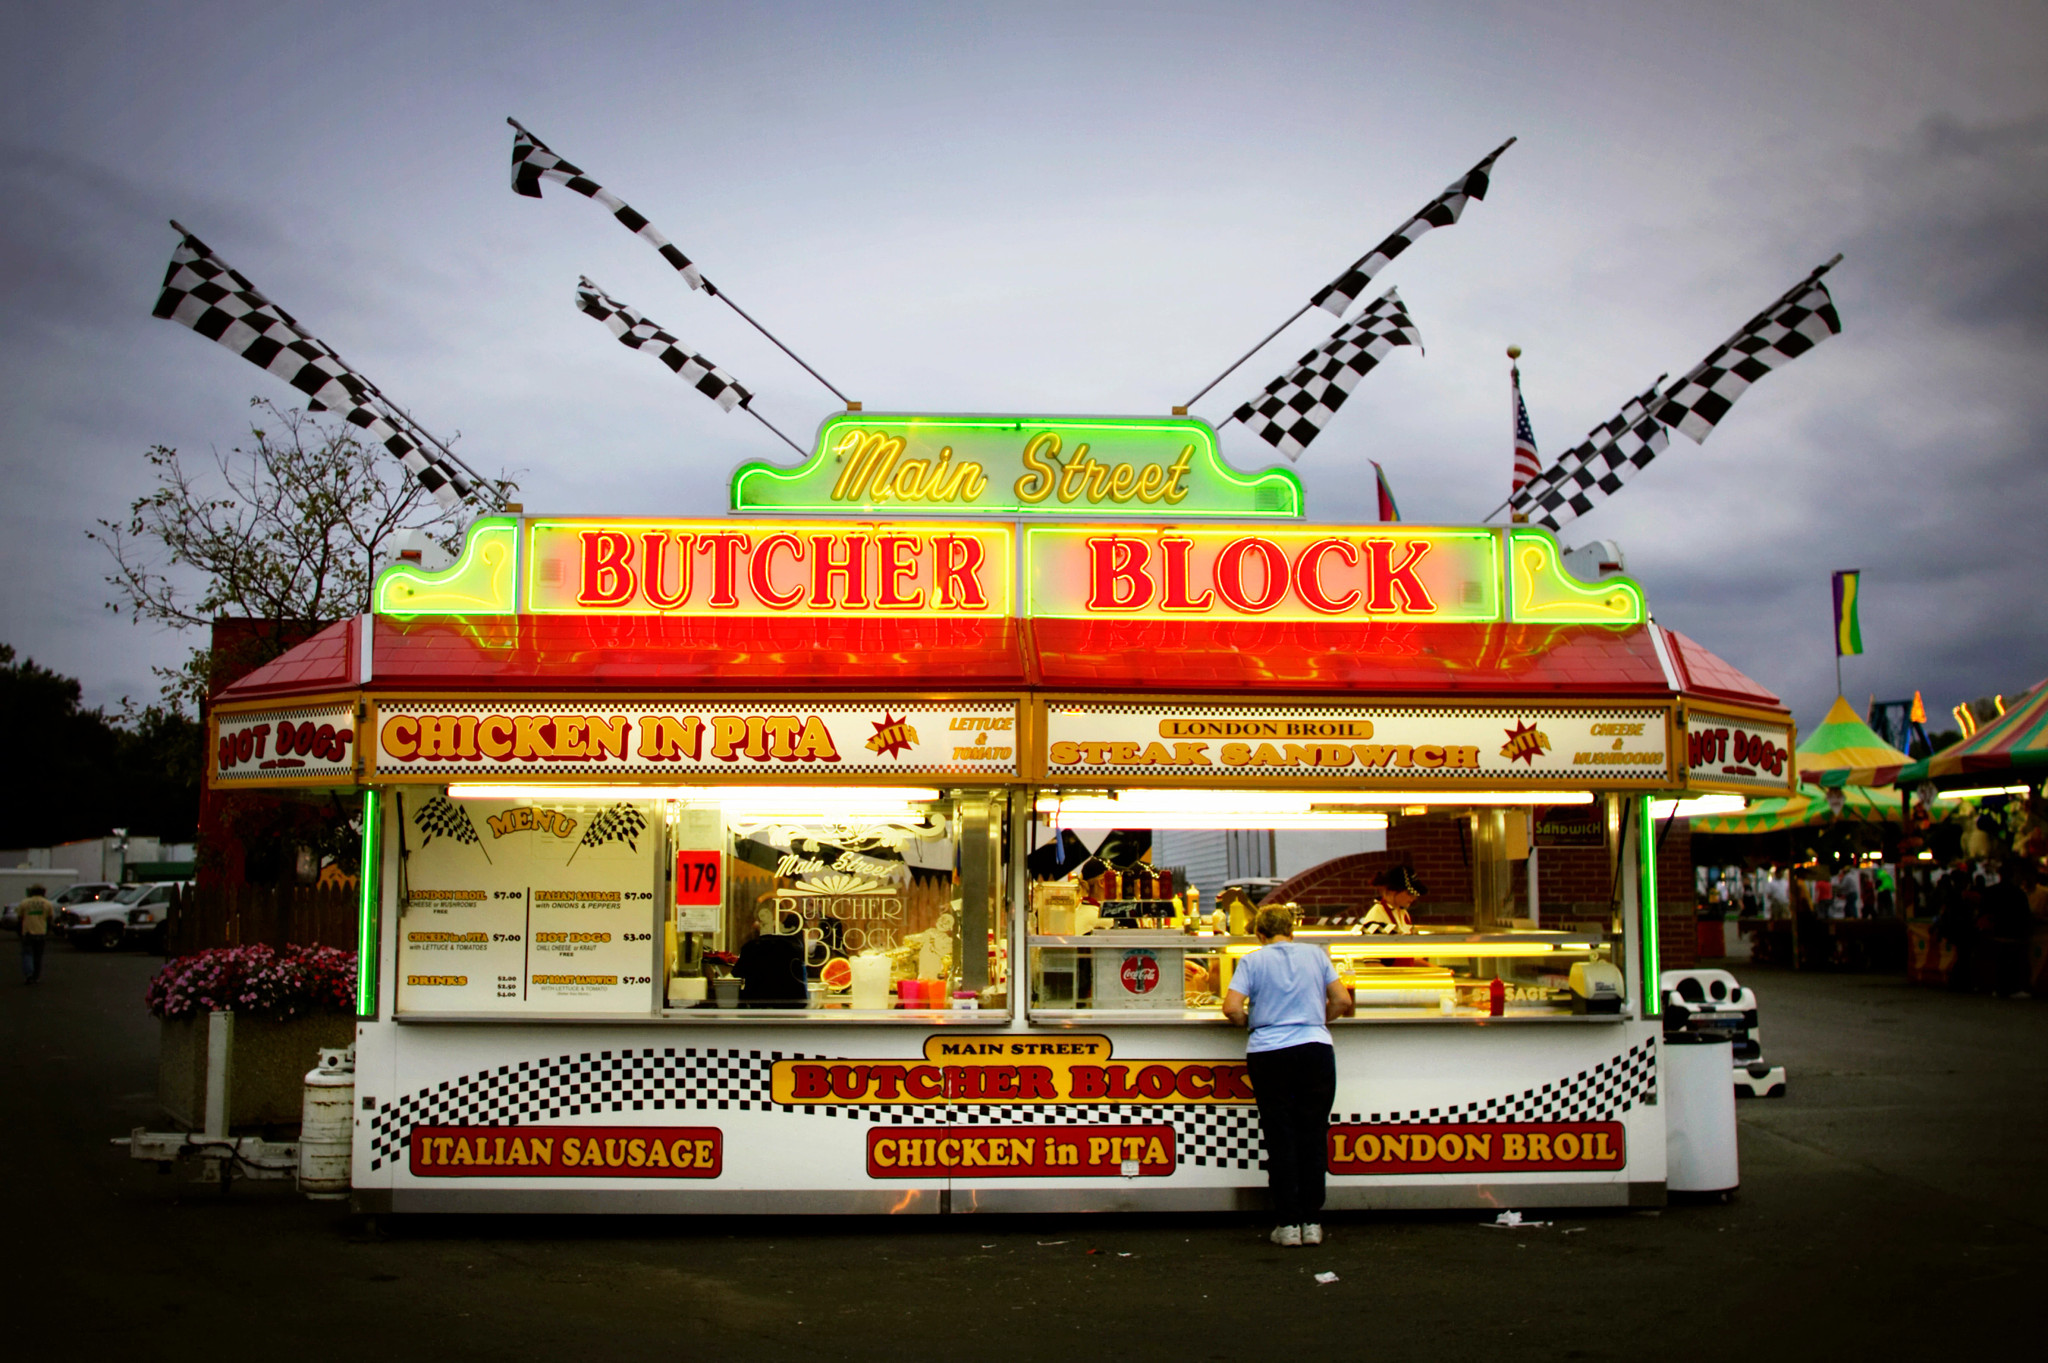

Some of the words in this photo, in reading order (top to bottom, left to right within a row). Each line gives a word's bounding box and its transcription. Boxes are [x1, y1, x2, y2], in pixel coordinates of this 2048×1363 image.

[830, 429, 988, 504] Main
[1014, 432, 1196, 505] Street
[577, 530, 988, 609] BUTCHER
[1087, 536, 1437, 614] BLOCK
[864, 723, 920, 752] WITH
[949, 717, 1015, 731] LETTUCE
[1173, 722, 1278, 736] LONDON
[1287, 722, 1361, 736] BROIL
[1590, 723, 1645, 736] CHEESE
[219, 723, 271, 771] HOT
[276, 721, 354, 762] DOGS
[381, 715, 632, 762] CHICKEN
[637, 715, 705, 762] IN
[711, 715, 841, 762] PITA
[975, 732, 988, 745] &
[1499, 730, 1552, 759] WITH
[1612, 737, 1624, 750] &
[952, 747, 1012, 760] TOMATO
[1050, 741, 1212, 766] STEAK
[1221, 743, 1480, 768] SANDWICH
[1573, 752, 1664, 765] MUSHROOMS
[1688, 729, 1729, 769] HOT
[1733, 729, 1788, 777] DOGS
[486, 807, 577, 839] MENU
[683, 863, 717, 893] 179
[774, 854, 824, 878] Main
[832, 851, 898, 878] Street
[409, 890, 453, 901] LONDON
[454, 890, 487, 901] BROIL
[494, 891, 522, 900] $7.00
[535, 890, 575, 901] ITALIAN
[576, 891, 621, 902] SAUSAGE
[624, 892, 652, 901] $7.00
[773, 897, 903, 936] BUTCHER
[408, 932, 450, 942] CHICKEN
[466, 932, 489, 942] PITA
[493, 933, 521, 942] $7.00
[536, 932, 568, 943] HOT
[569, 932, 611, 943] DOGS
[623, 933, 652, 941] $3.00
[802, 927, 899, 967] BLOCK
[407, 975, 468, 986] DRINKS
[532, 975, 548, 985] POT
[549, 975, 575, 985] ROAST
[575, 975, 618, 985] SANDWICH
[623, 976, 651, 985] $7.00
[941, 1043, 1004, 1055] MAIN
[1011, 1043, 1099, 1055] STREET
[791, 1064, 1058, 1099] BUTCHER
[1069, 1064, 1256, 1099] BLOCK
[420, 1136, 554, 1166] ITALIAN
[562, 1137, 714, 1168] SAUSAGE
[873, 1138, 1036, 1167] CHICKEN
[1045, 1137, 1079, 1166] in
[1088, 1136, 1169, 1166] PITA
[1332, 1133, 1492, 1162] LONDON
[1502, 1132, 1617, 1161] BROIL
